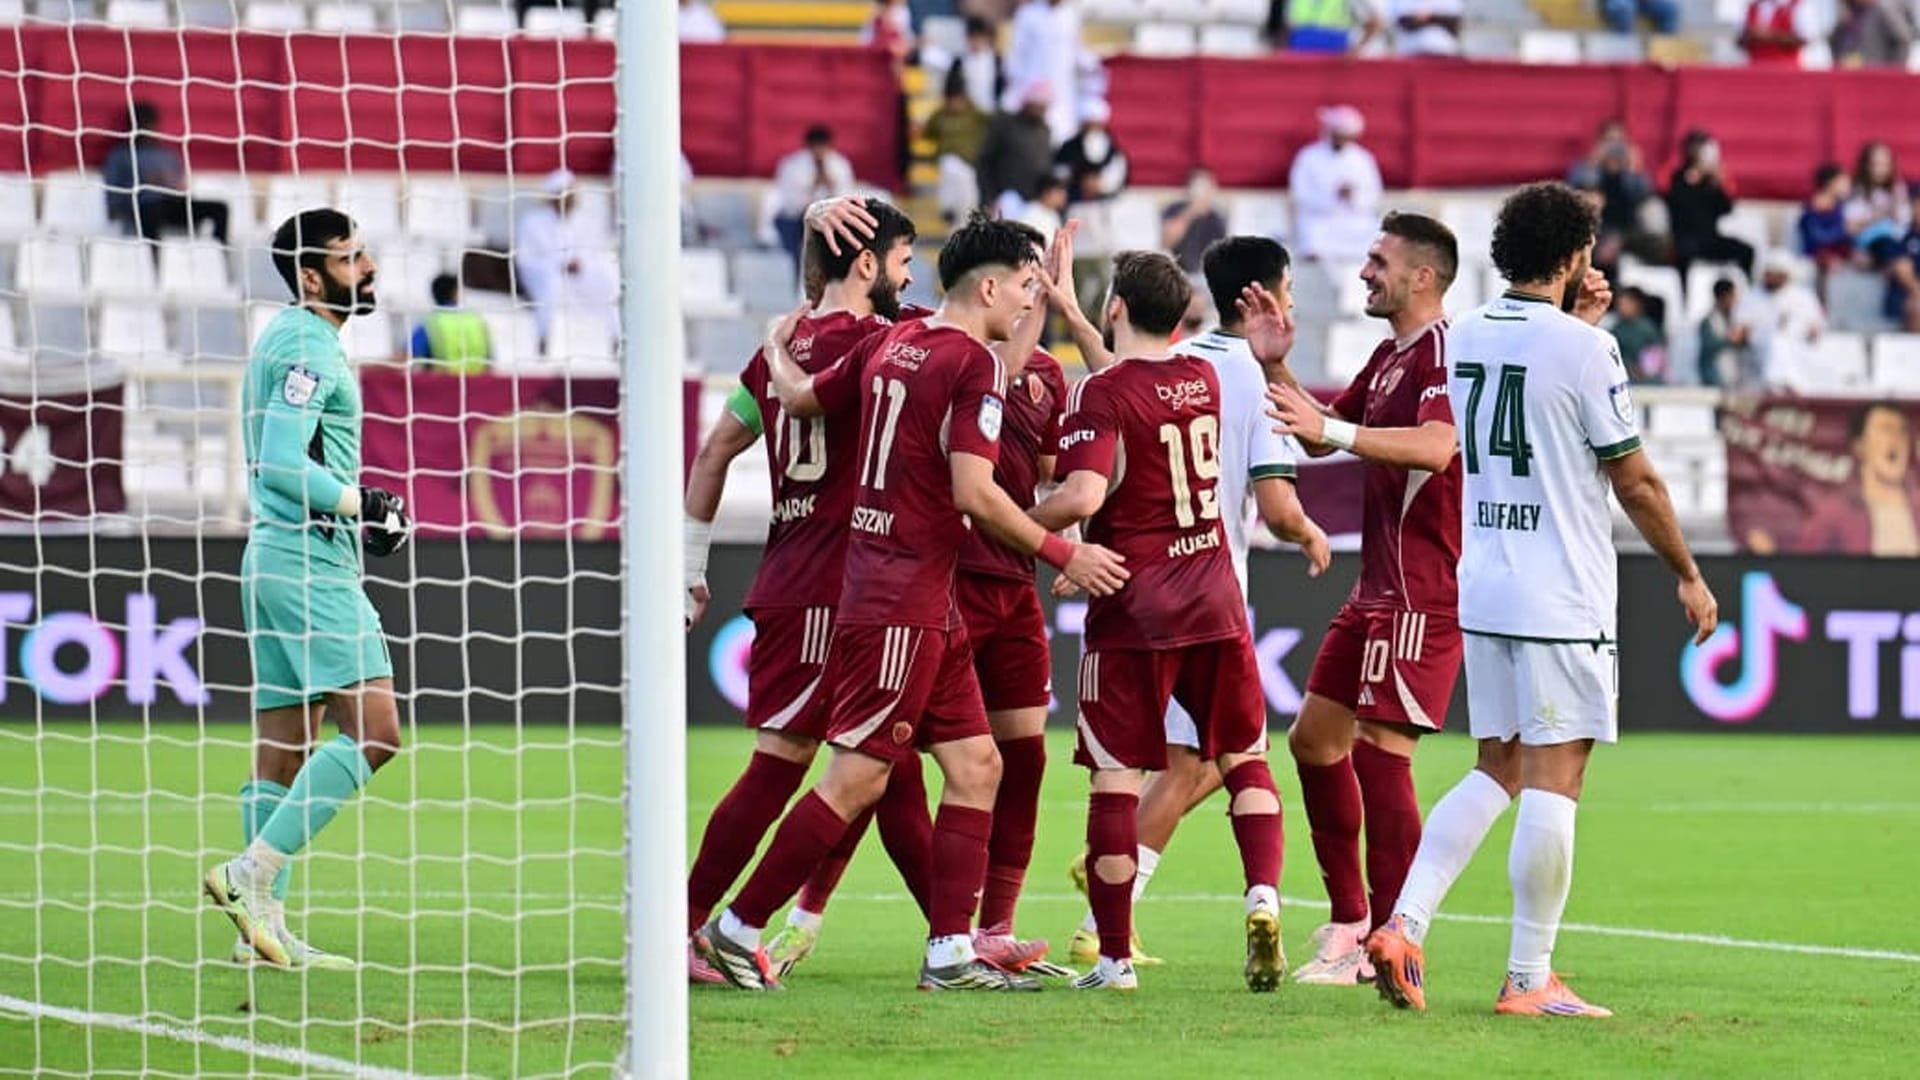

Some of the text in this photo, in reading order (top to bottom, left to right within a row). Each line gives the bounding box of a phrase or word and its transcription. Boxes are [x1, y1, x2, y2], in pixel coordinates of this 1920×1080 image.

[860, 375, 906, 490] 11
[1159, 414, 1221, 528] 19
[1454, 361, 1534, 477] 74
